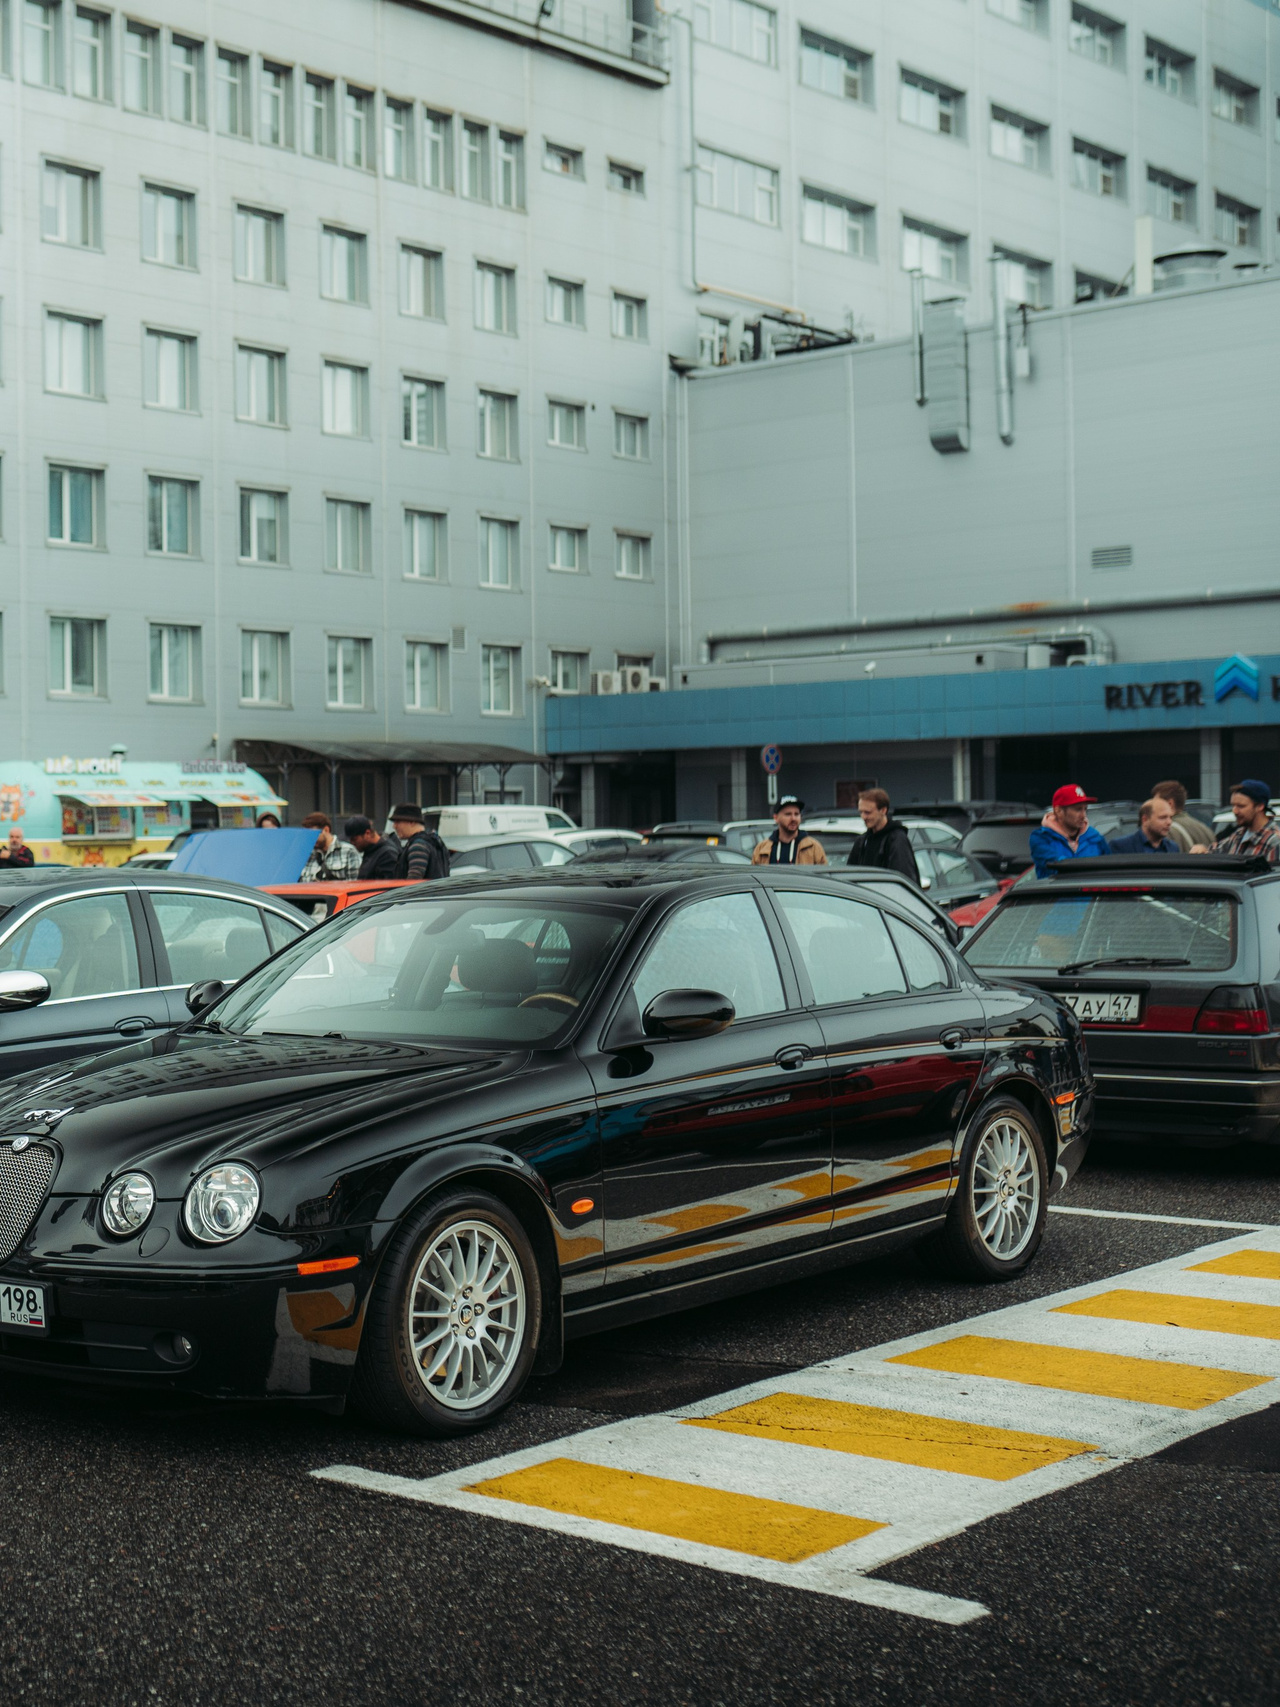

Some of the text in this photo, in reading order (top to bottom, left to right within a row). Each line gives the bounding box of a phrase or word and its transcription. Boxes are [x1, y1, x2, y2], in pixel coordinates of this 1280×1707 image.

[1104, 679, 1205, 711] RIVER
[1112, 996, 1132, 1010] 47
[2, 1286, 38, 1313] 198
[10, 1312, 29, 1323] RUS
